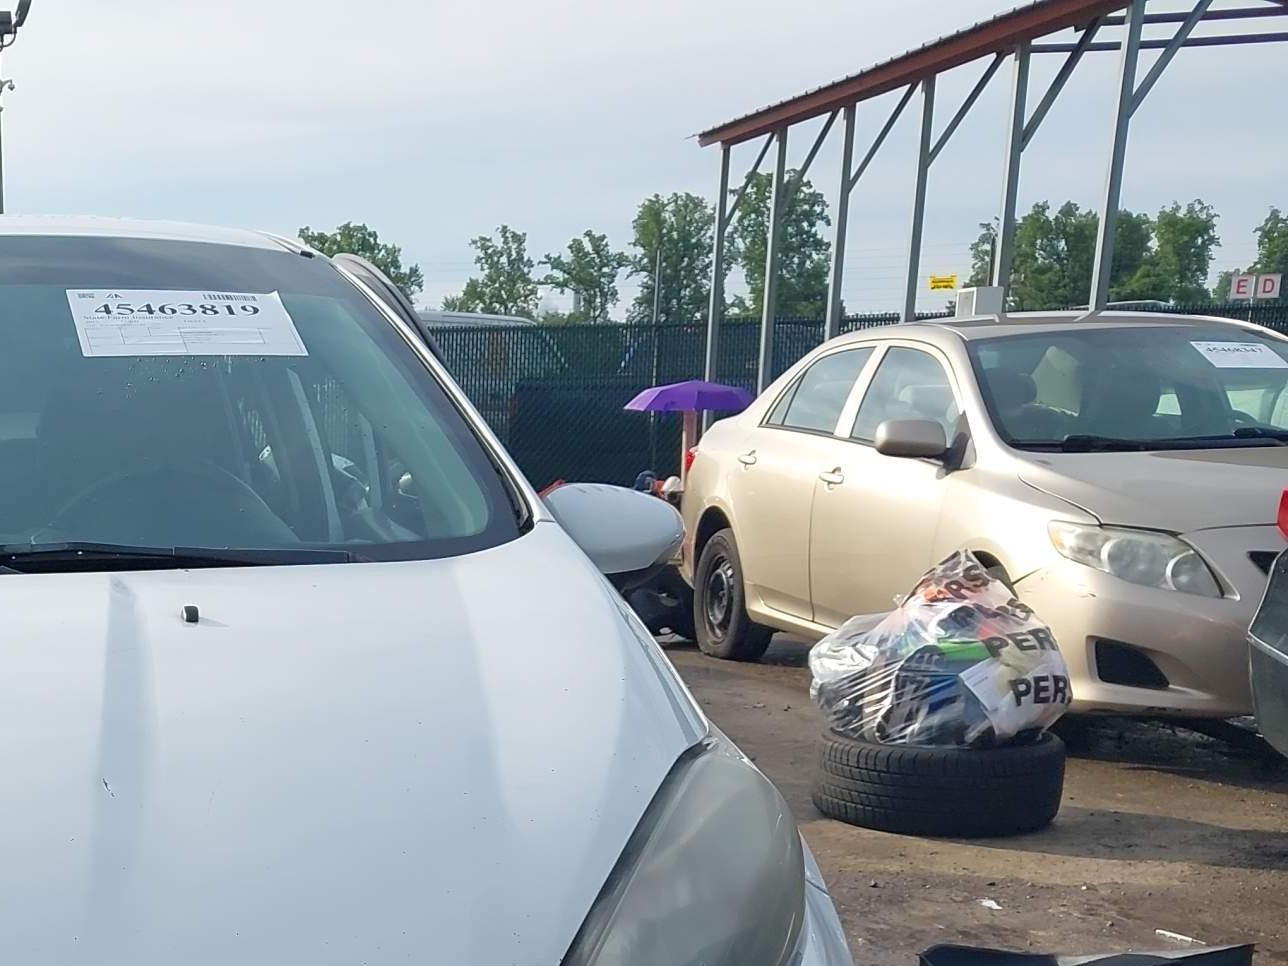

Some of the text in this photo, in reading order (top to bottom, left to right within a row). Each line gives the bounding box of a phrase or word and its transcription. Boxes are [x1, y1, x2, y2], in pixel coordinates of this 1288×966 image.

[1236, 278, 1249, 295] E
[1262, 278, 1275, 294] D
[94, 302, 261, 317] 45463819
